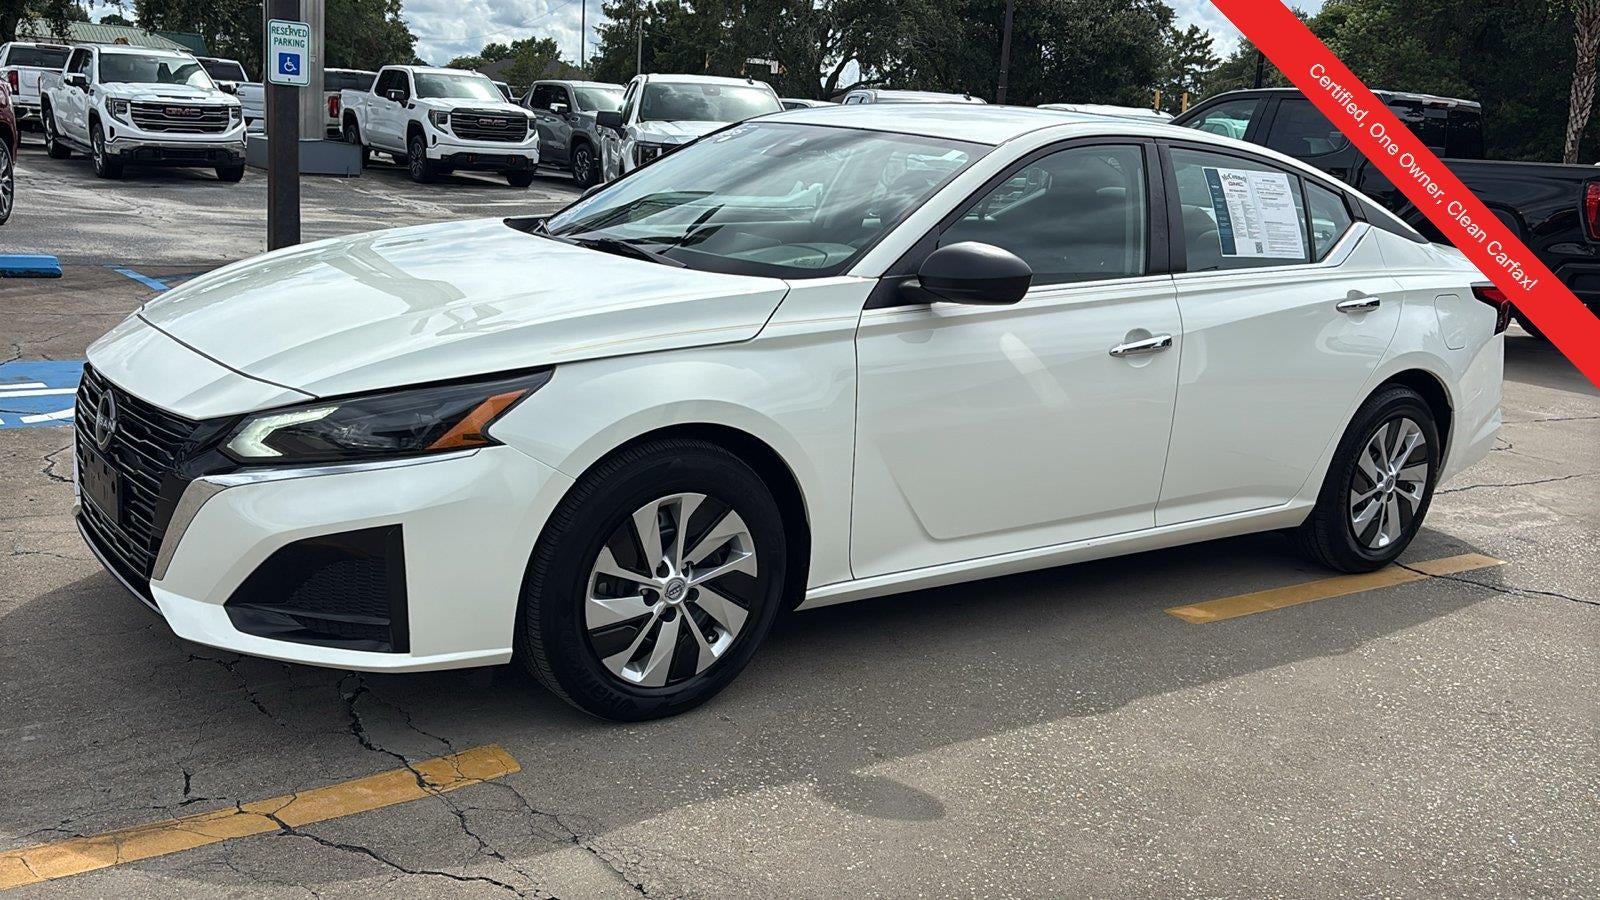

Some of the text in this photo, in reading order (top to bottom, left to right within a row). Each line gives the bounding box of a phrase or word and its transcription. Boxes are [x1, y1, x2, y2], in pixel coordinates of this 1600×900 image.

[271, 25, 308, 38] RESERVED
[273, 37, 306, 48] PARKING
[165, 107, 201, 115] GMC
[479, 118, 507, 126] GMC
